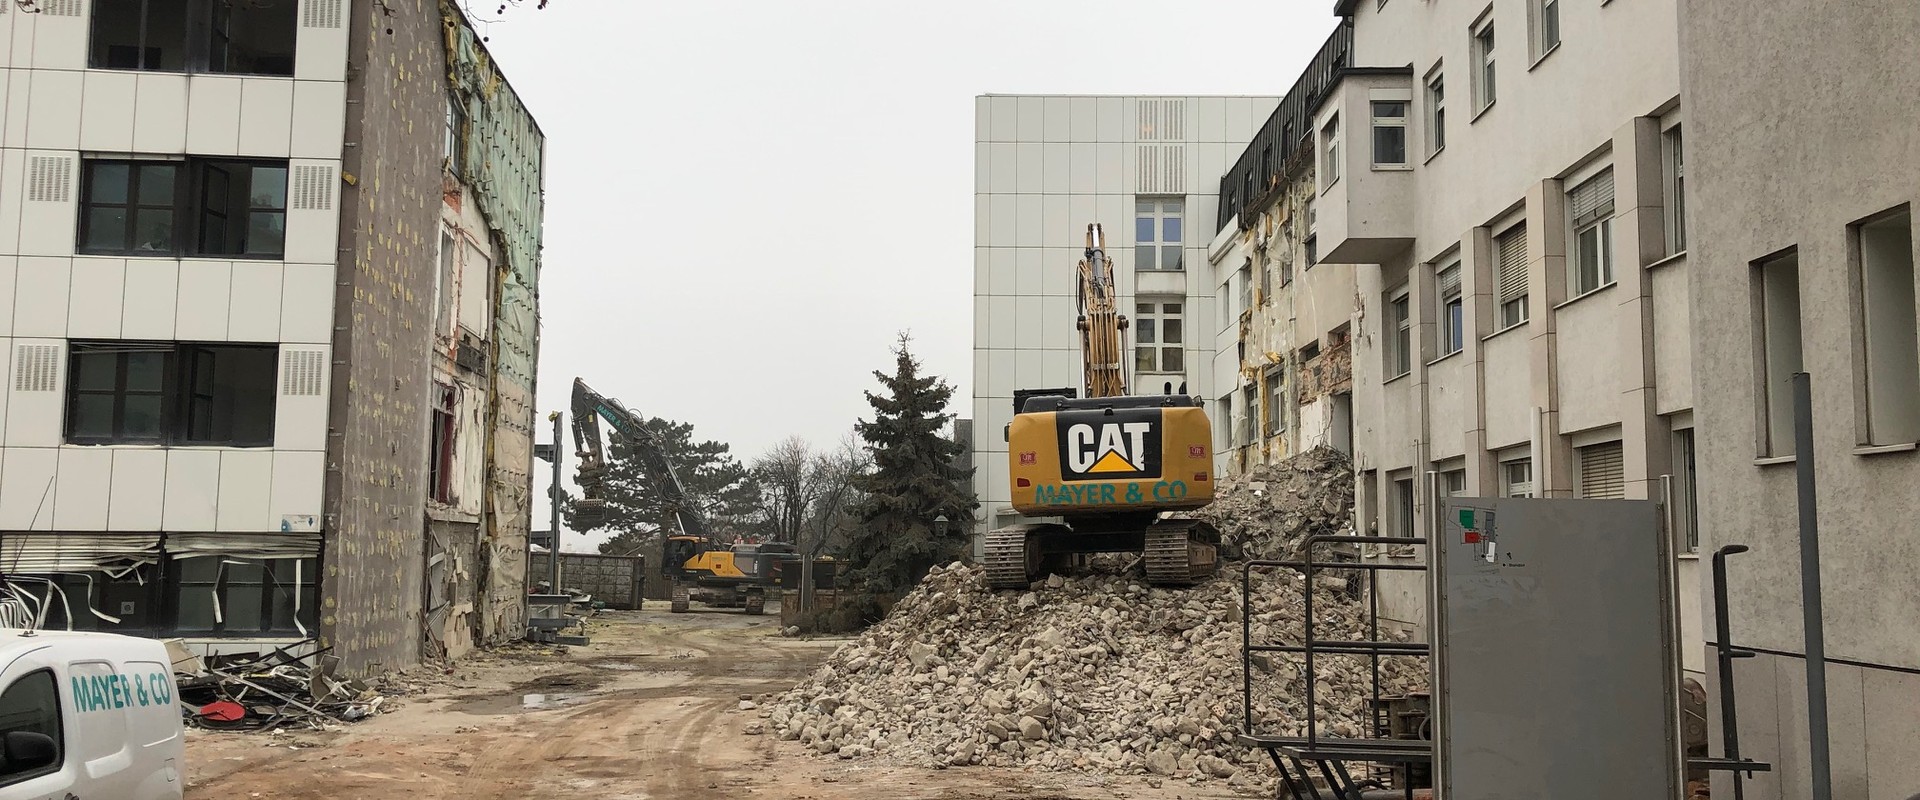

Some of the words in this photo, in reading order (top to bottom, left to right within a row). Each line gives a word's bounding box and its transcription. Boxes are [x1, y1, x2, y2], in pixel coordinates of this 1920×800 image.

[596, 404, 616, 422] MAYER
[1067, 422, 1150, 474] CAT
[1035, 482, 1115, 505] MAYER
[1125, 482, 1144, 504] &
[1152, 480, 1187, 503] CO
[71, 674, 134, 713] MAYER
[134, 673, 150, 707] &
[149, 672, 171, 706] CO
